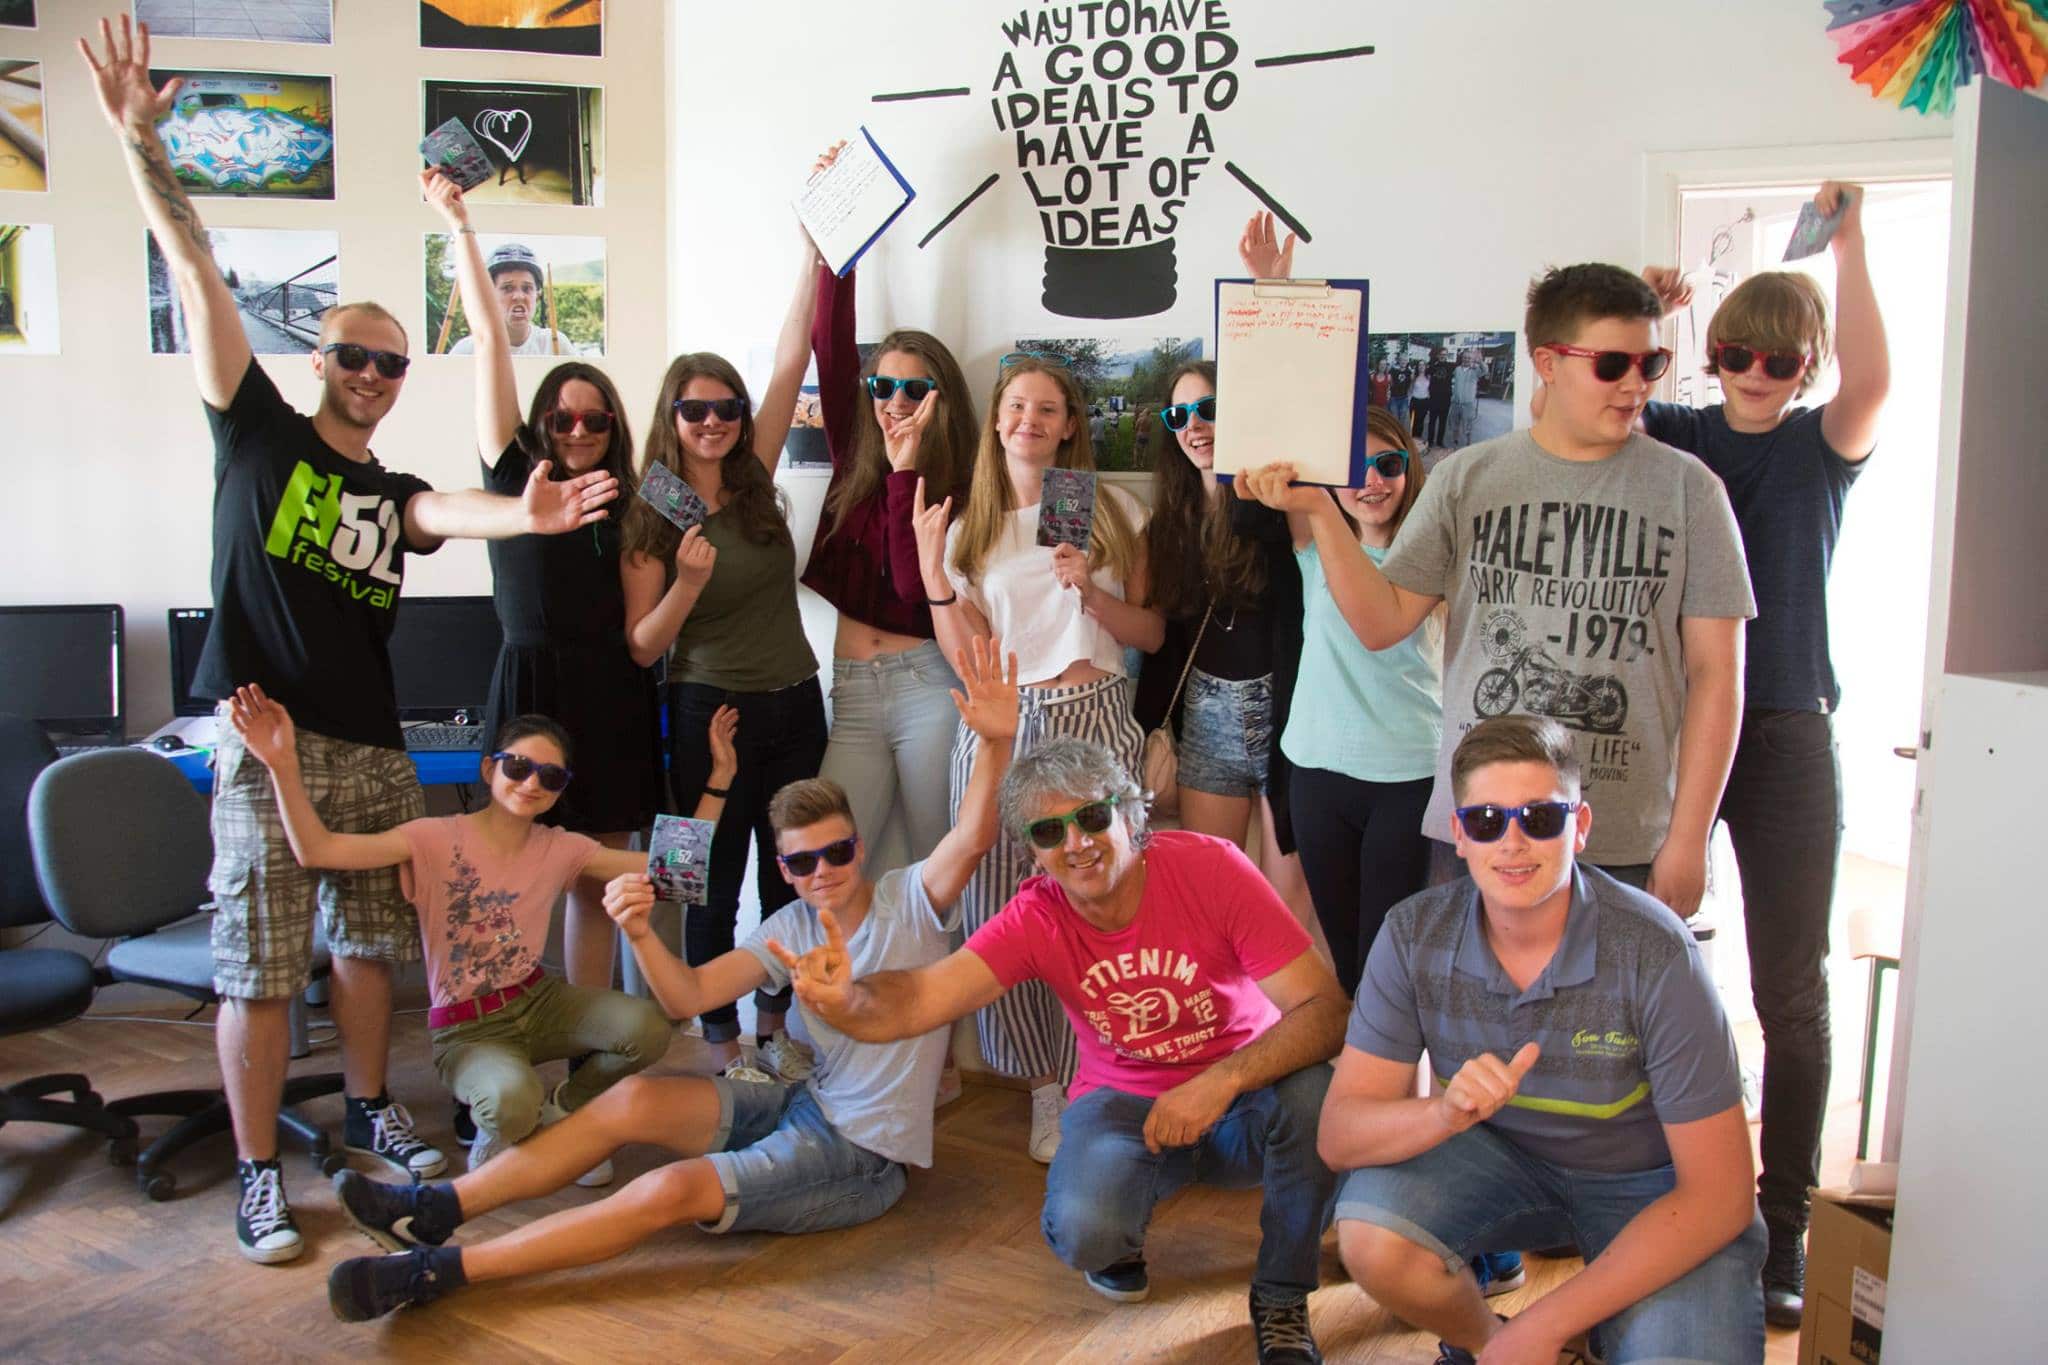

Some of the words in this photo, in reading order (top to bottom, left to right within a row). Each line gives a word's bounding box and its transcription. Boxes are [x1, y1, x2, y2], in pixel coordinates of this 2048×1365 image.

[1078, 0, 1130, 39] TO
[992, 52, 1023, 91] A
[1045, 31, 1239, 85] GOOD
[1167, 70, 1239, 113] TO
[1186, 113, 1215, 153] A
[1022, 162, 1129, 207] LOT
[1149, 157, 1211, 197] OF
[1039, 200, 1186, 246] IDEAS
[1470, 502, 1675, 579] HALEYVILLE
[1192, 999, 1218, 1024] 12
[1174, 1027, 1215, 1049] TRUST
